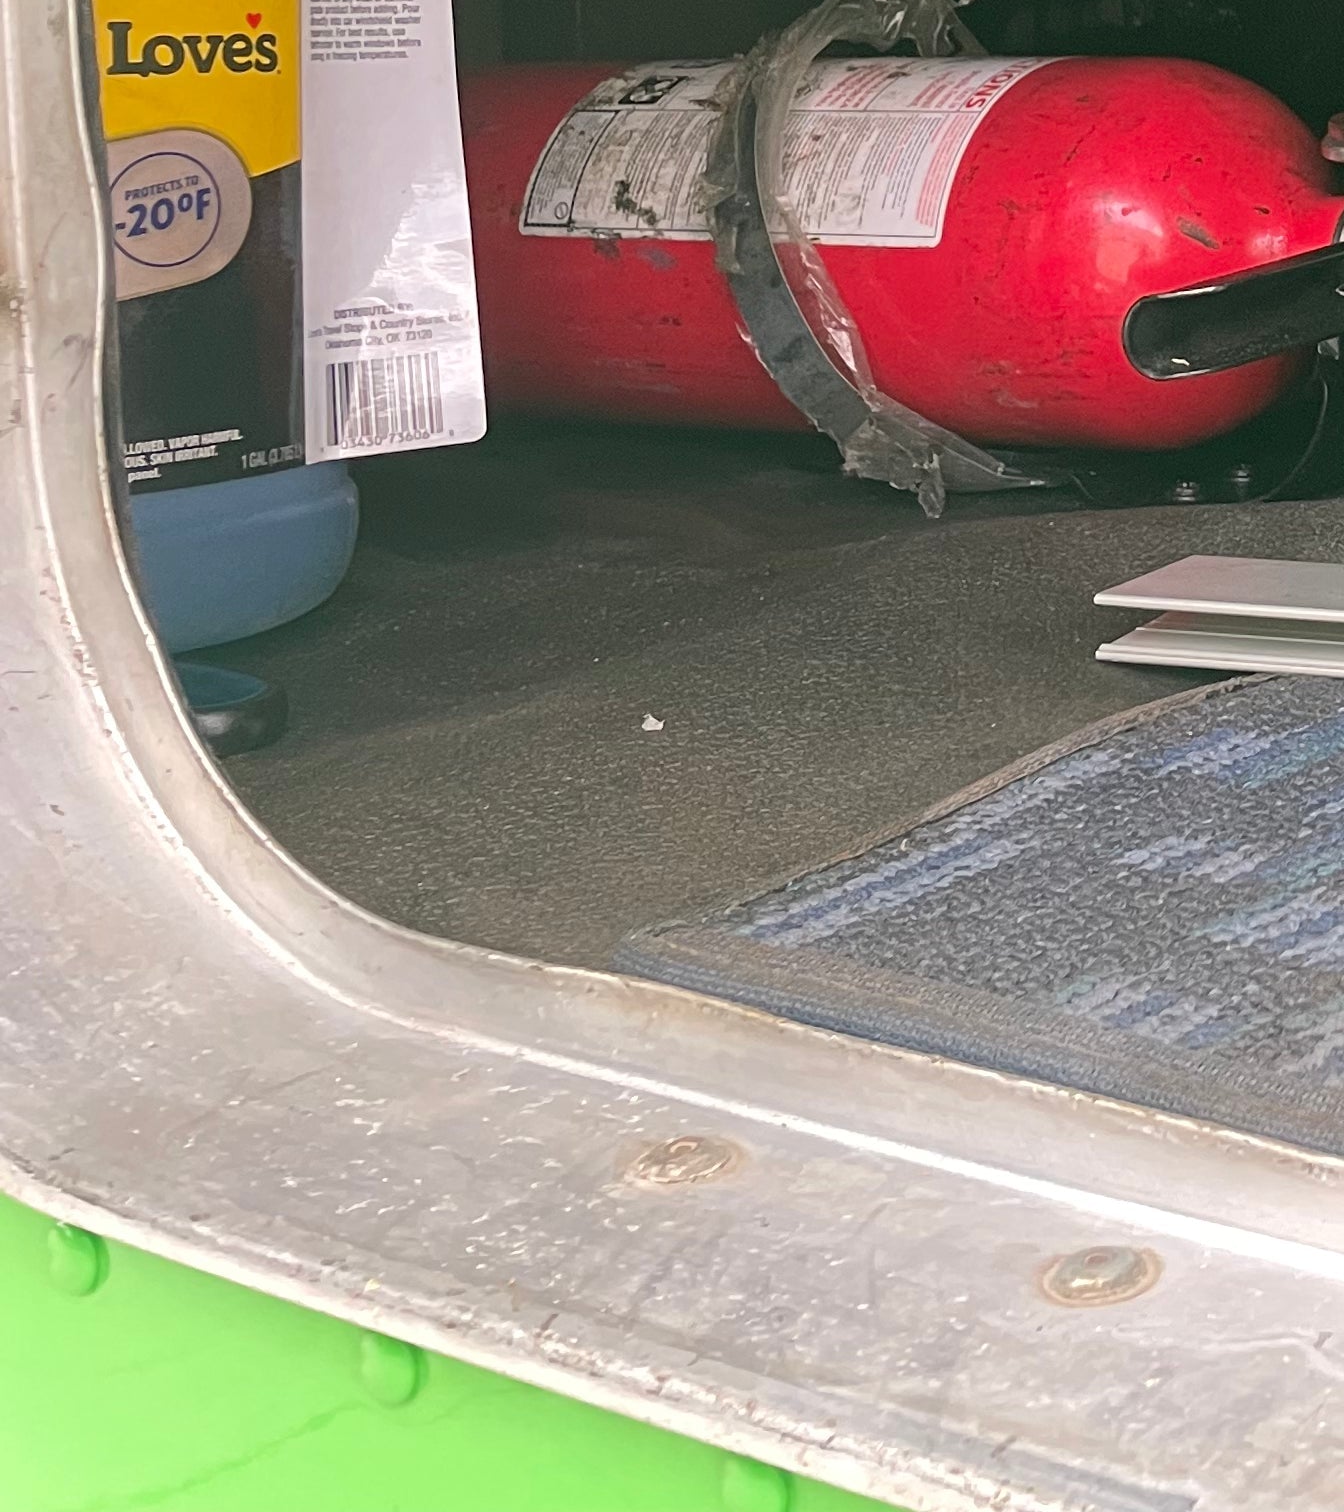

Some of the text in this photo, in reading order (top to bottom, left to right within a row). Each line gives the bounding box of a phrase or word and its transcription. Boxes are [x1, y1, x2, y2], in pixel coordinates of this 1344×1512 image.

[124, 174, 200, 202] PROTECTS TO
[168, 434, 200, 450] VAPOR
[149, 451, 174, 466] SKIN
